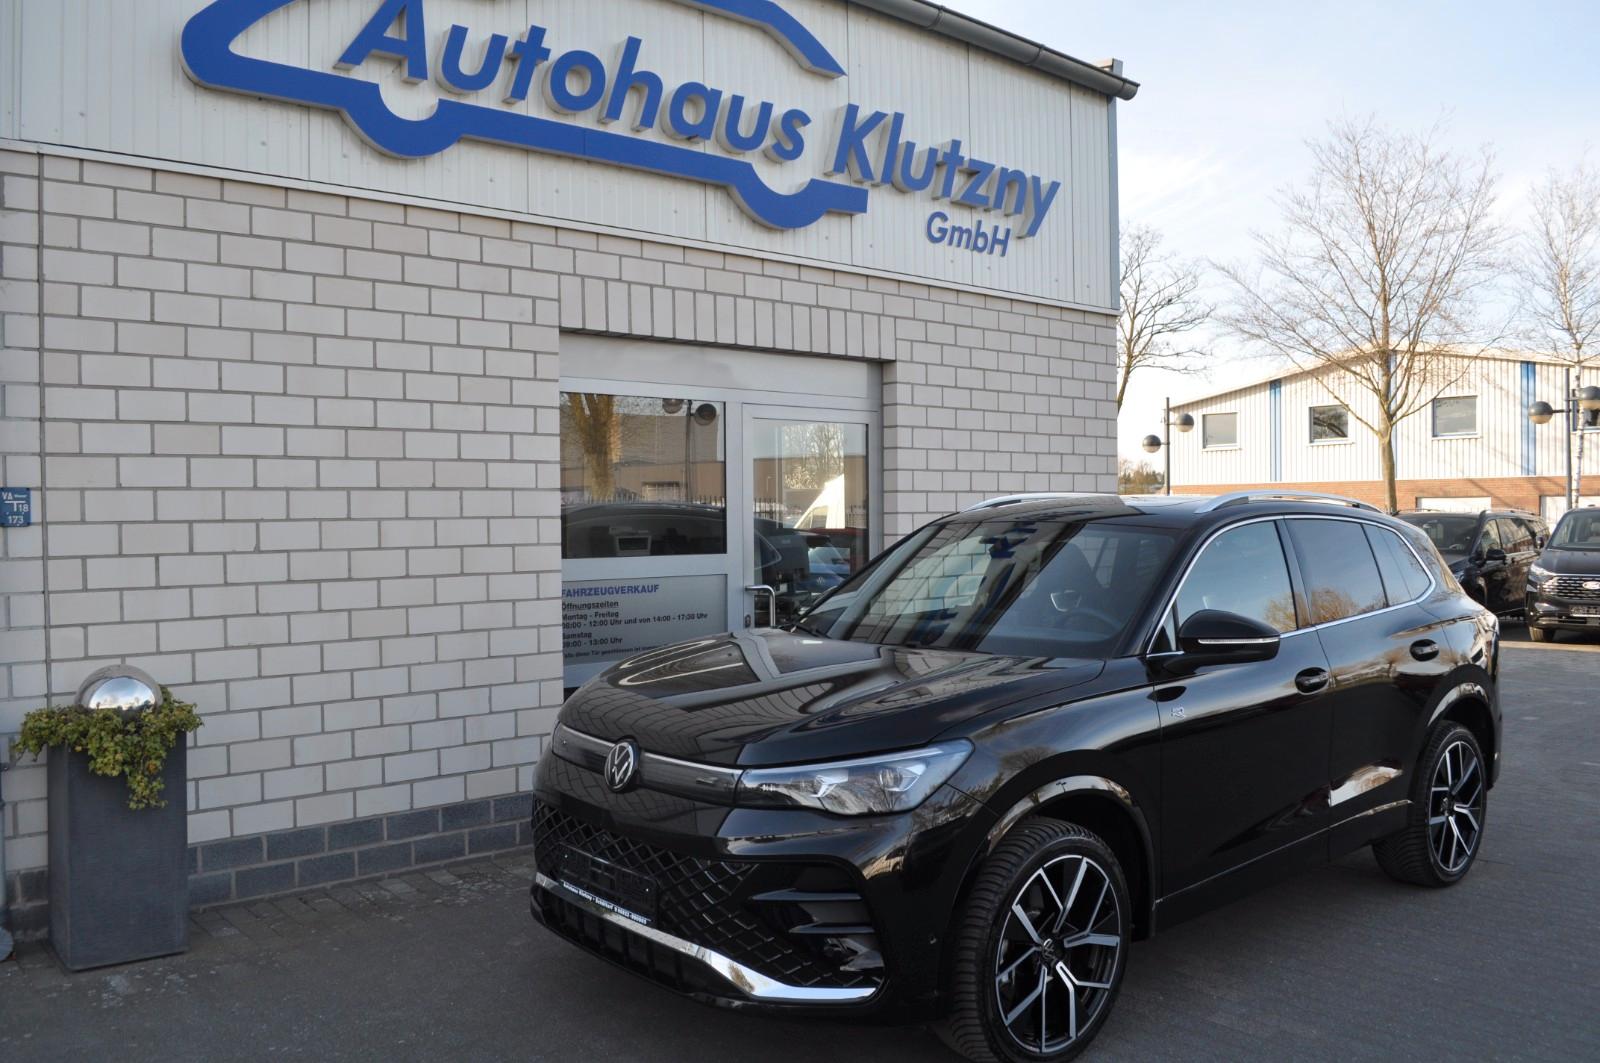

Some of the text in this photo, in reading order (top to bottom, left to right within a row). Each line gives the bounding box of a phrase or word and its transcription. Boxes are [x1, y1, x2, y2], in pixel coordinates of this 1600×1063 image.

[334, 0, 1061, 238] Autohaus Klutzny
[926, 211, 1011, 258] GmbH
[562, 584, 660, 597] FAHRZEUGVERKAUF
